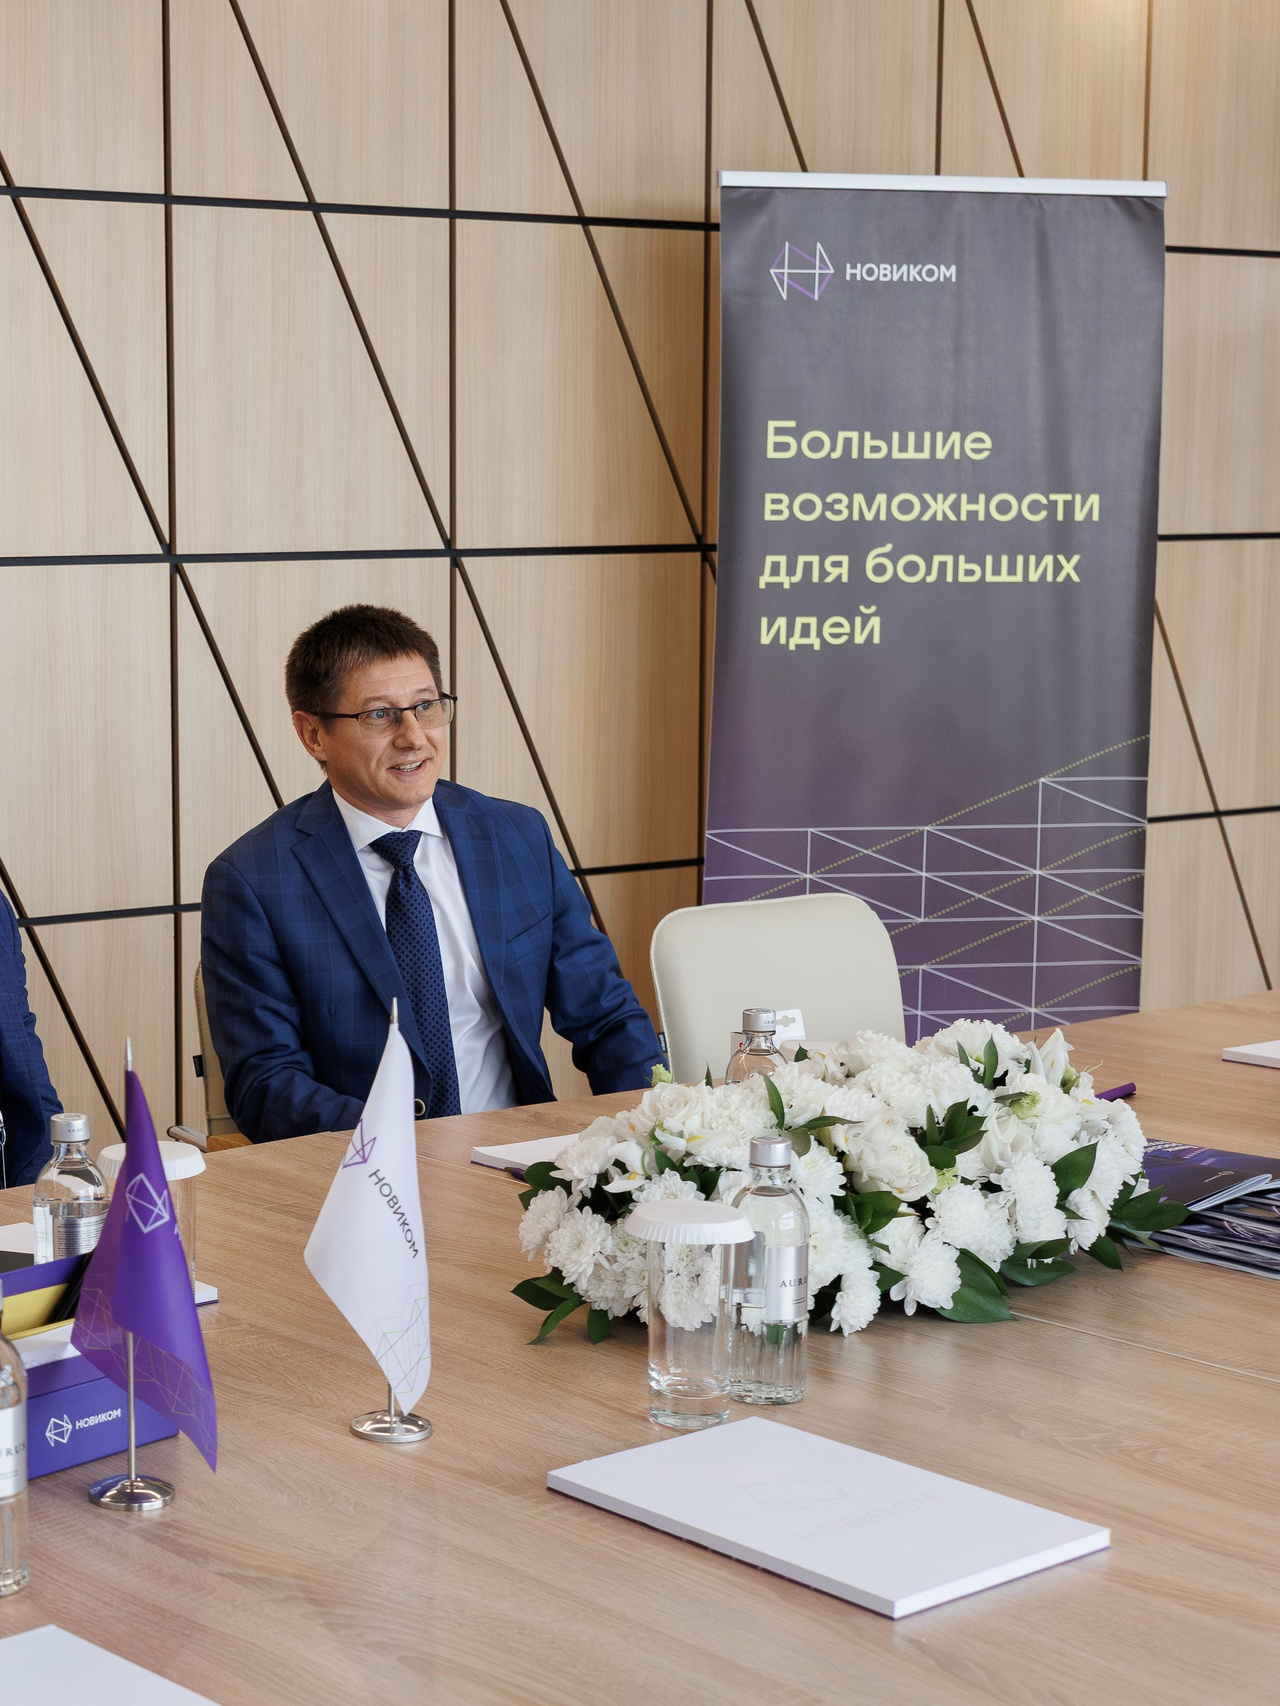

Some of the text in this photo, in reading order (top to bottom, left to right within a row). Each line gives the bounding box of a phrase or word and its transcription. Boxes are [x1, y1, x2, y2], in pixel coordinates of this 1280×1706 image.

[845, 262, 958, 284] НОВИКОМ
[765, 419, 993, 461] Большие
[763, 492, 1101, 522] возможности
[758, 542, 1082, 590] для больших
[759, 604, 882, 651] идей
[367, 1168, 419, 1260] НОВИКОМ
[75, 1407, 122, 1430] НОВИКОМ
